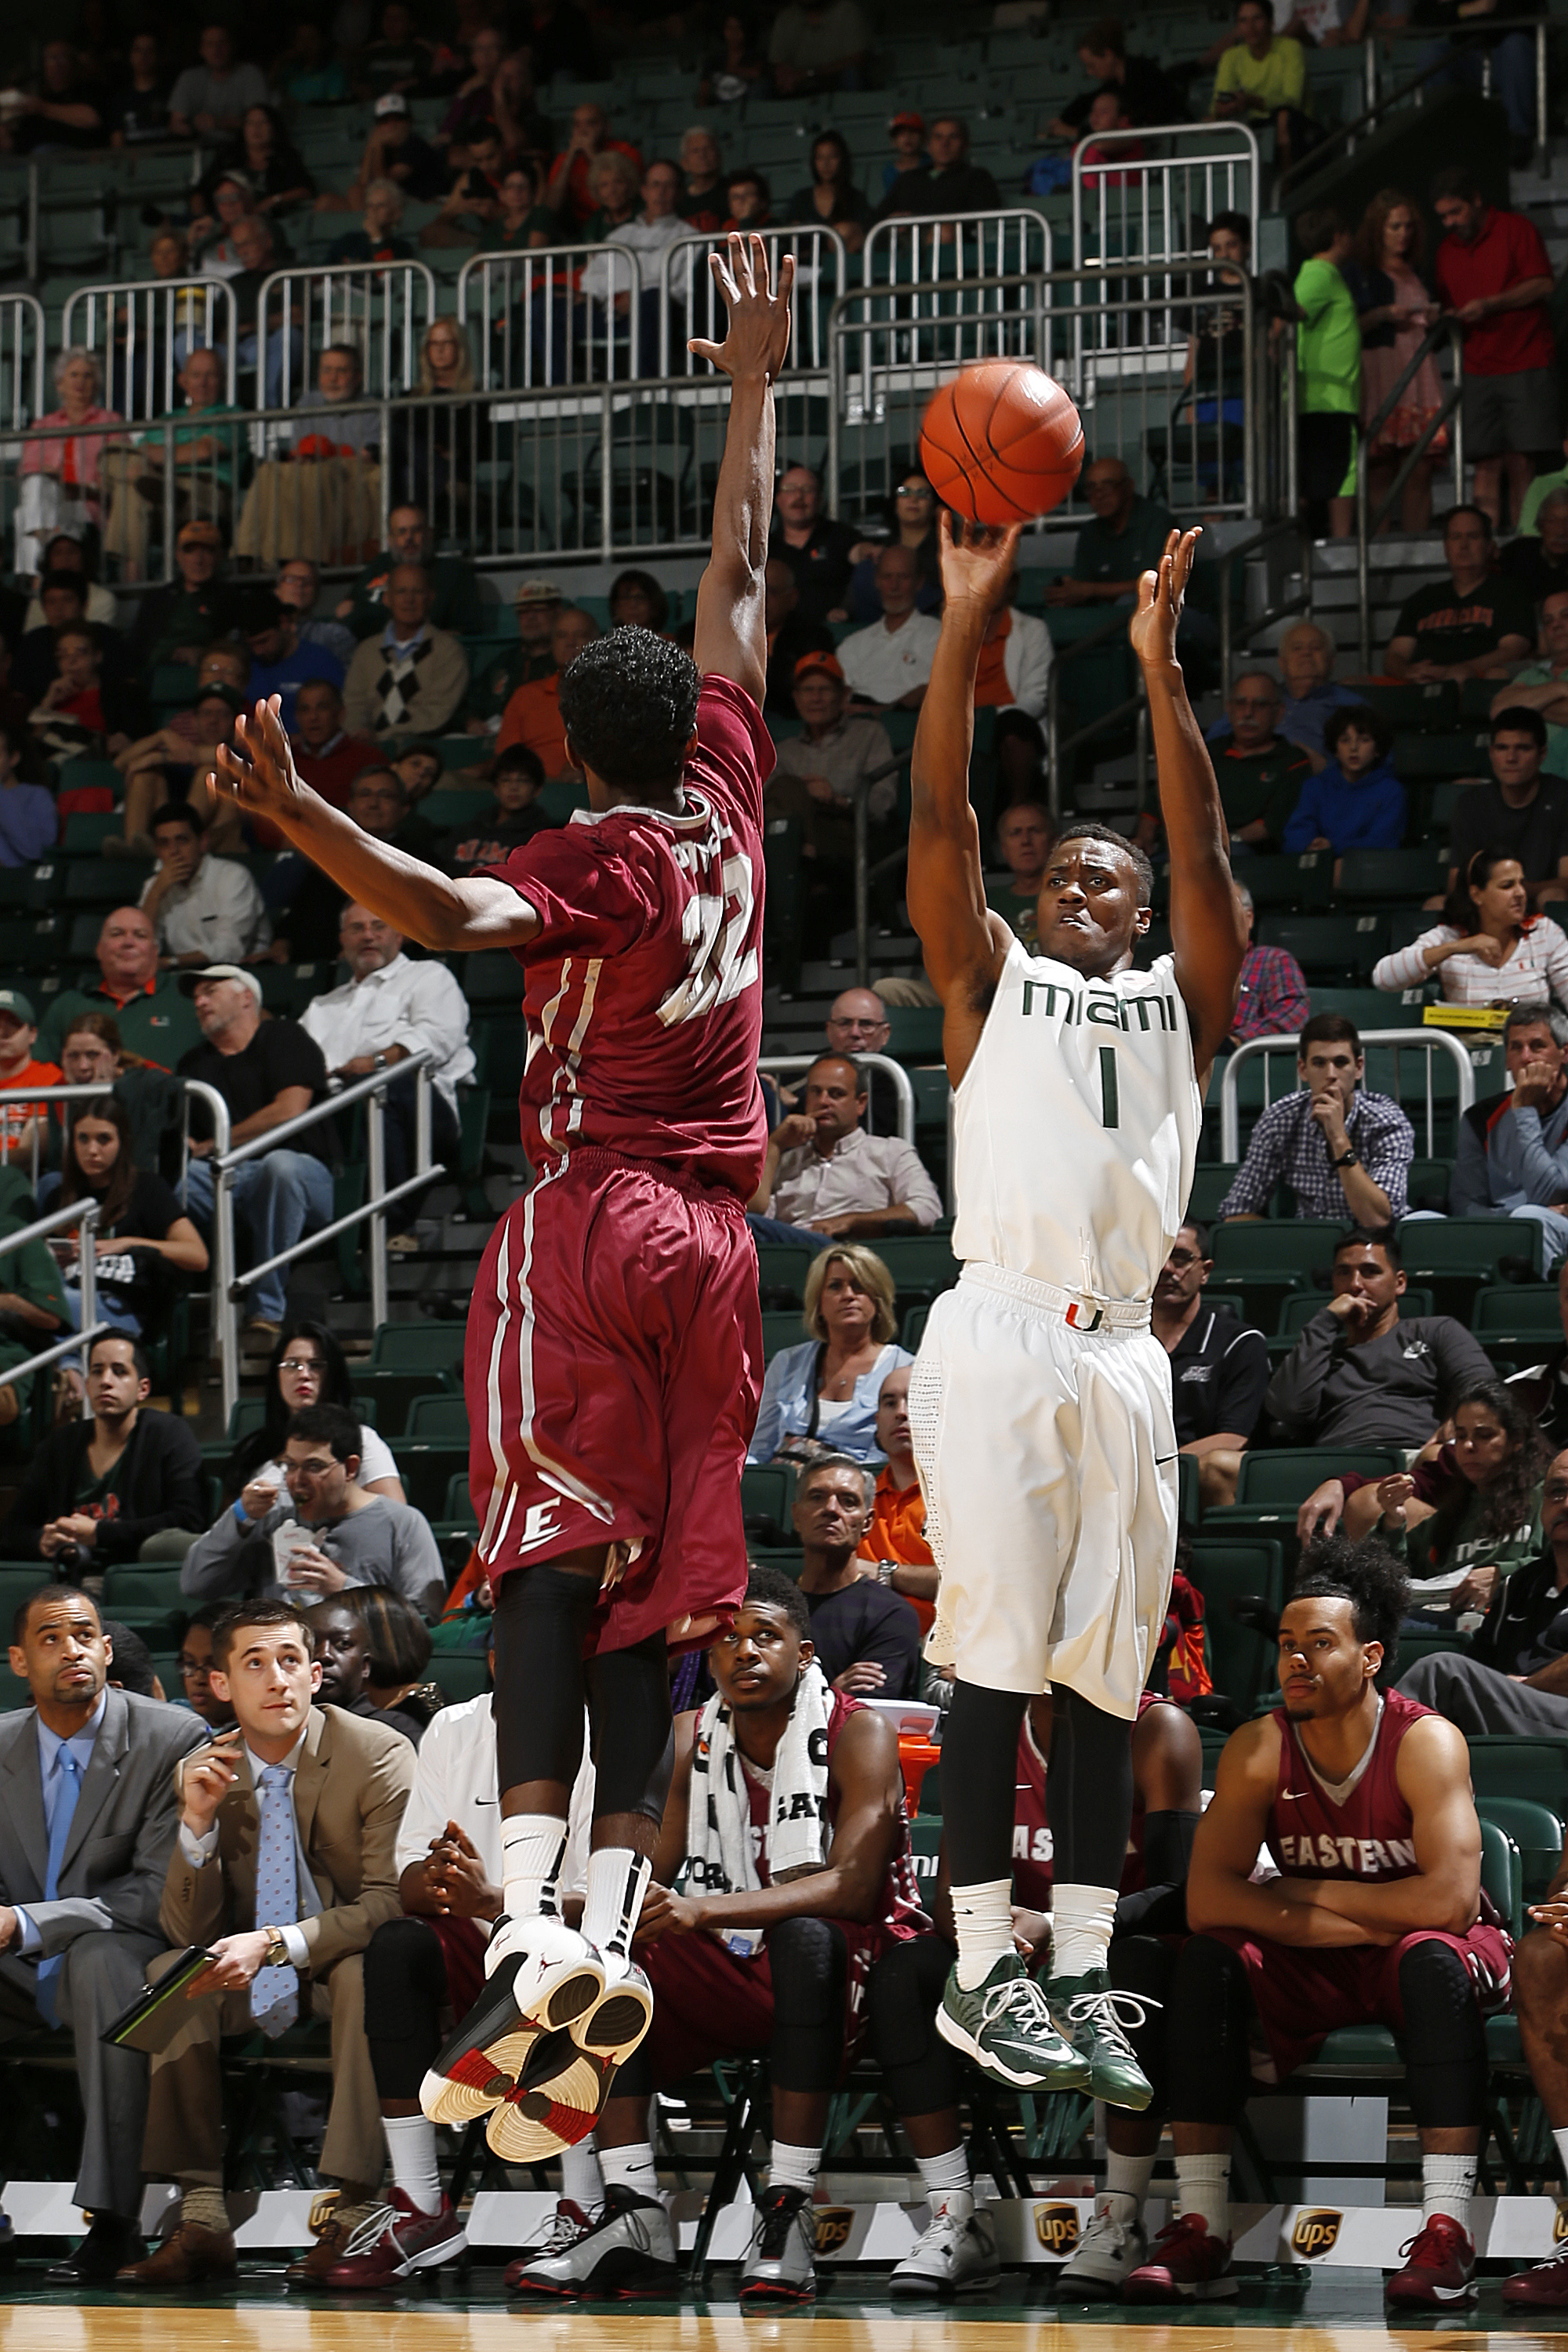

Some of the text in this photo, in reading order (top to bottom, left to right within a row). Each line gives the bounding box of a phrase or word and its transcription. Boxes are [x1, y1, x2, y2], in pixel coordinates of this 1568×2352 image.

[655, 852, 759, 1028] 32
[1098, 1047, 1120, 1129] 1
[520, 1495, 564, 1549] E
[1011, 1824, 1054, 1863] AS
[1279, 1833, 1417, 1873] EASTERN
[1038, 2218, 1078, 2249] ups
[1295, 2223, 1338, 2252] ups
